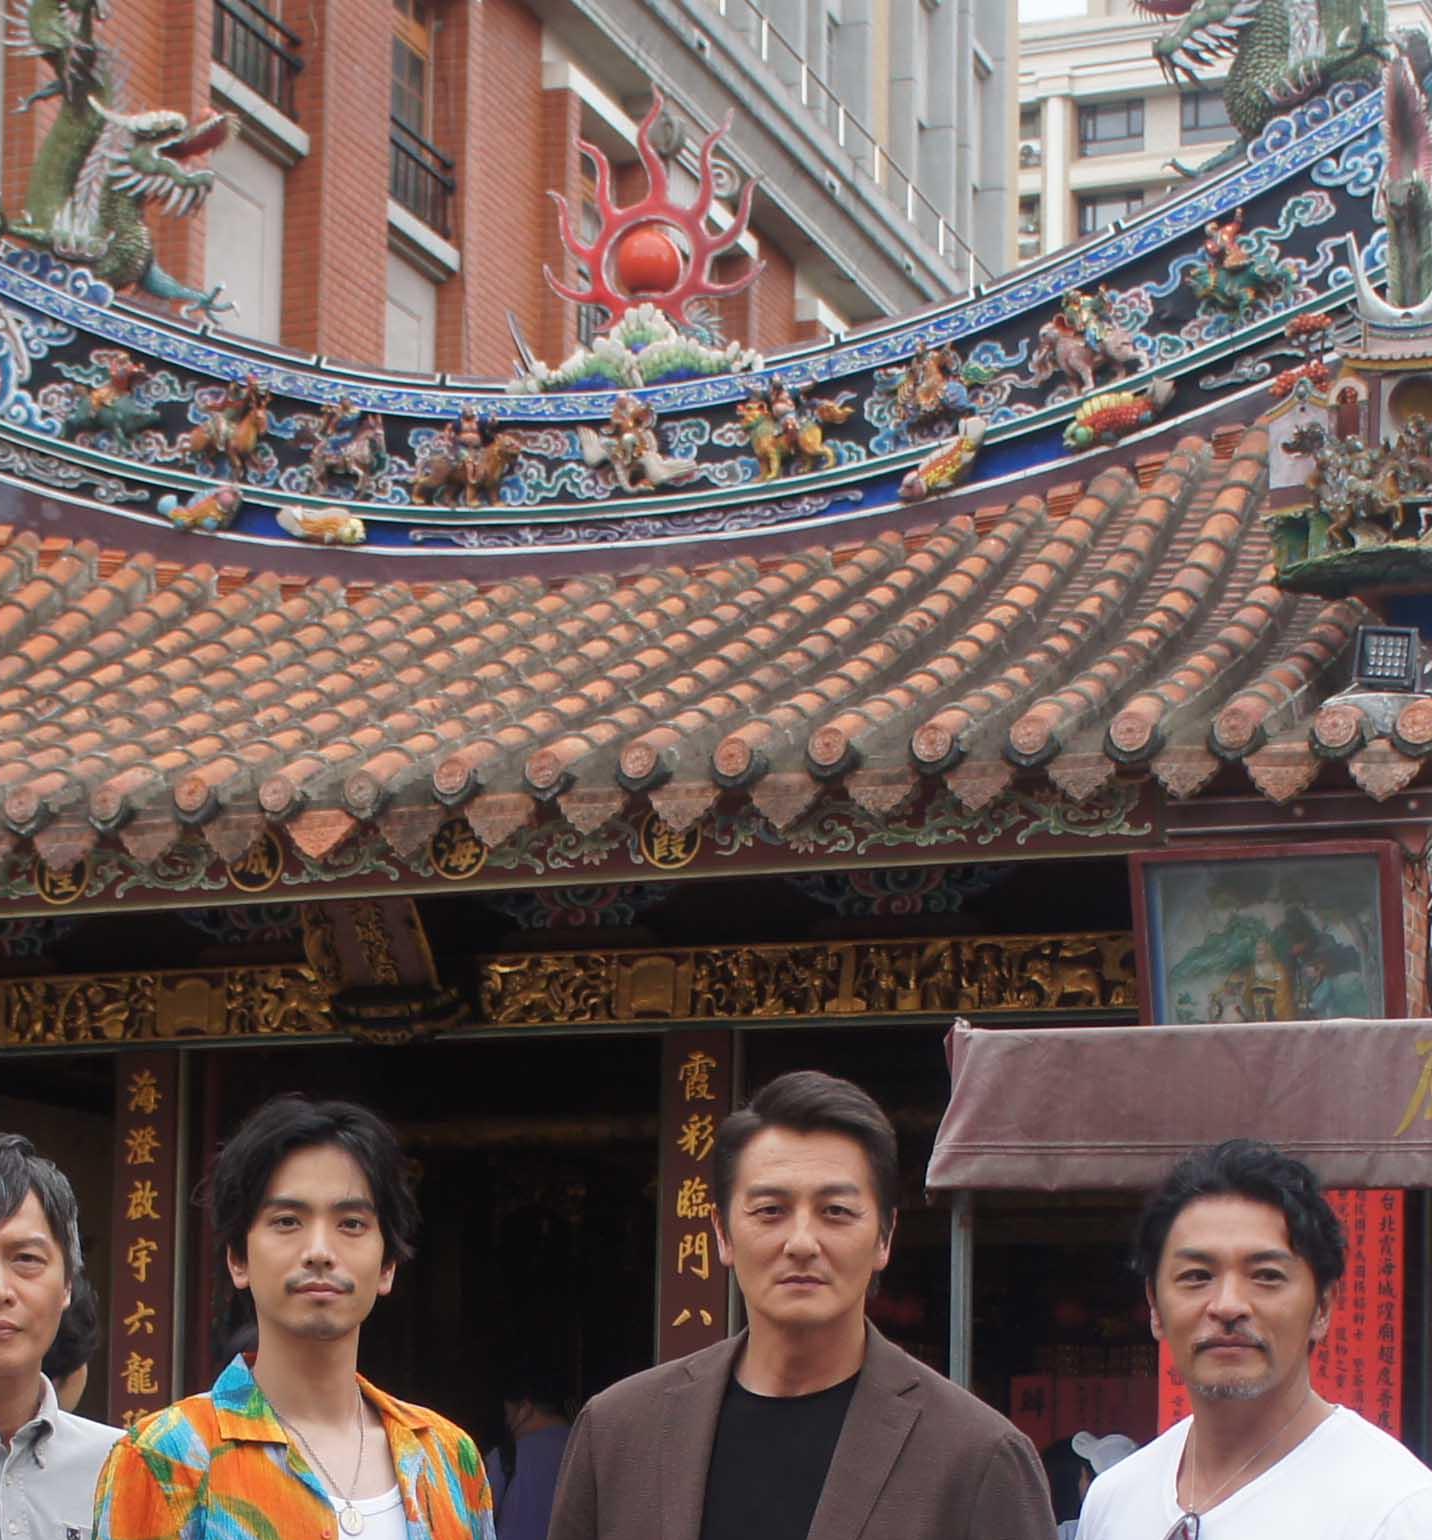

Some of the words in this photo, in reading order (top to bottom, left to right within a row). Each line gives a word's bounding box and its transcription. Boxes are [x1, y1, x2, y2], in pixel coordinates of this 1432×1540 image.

[120, 1069, 163, 1428] 海澄啟宇六龍
